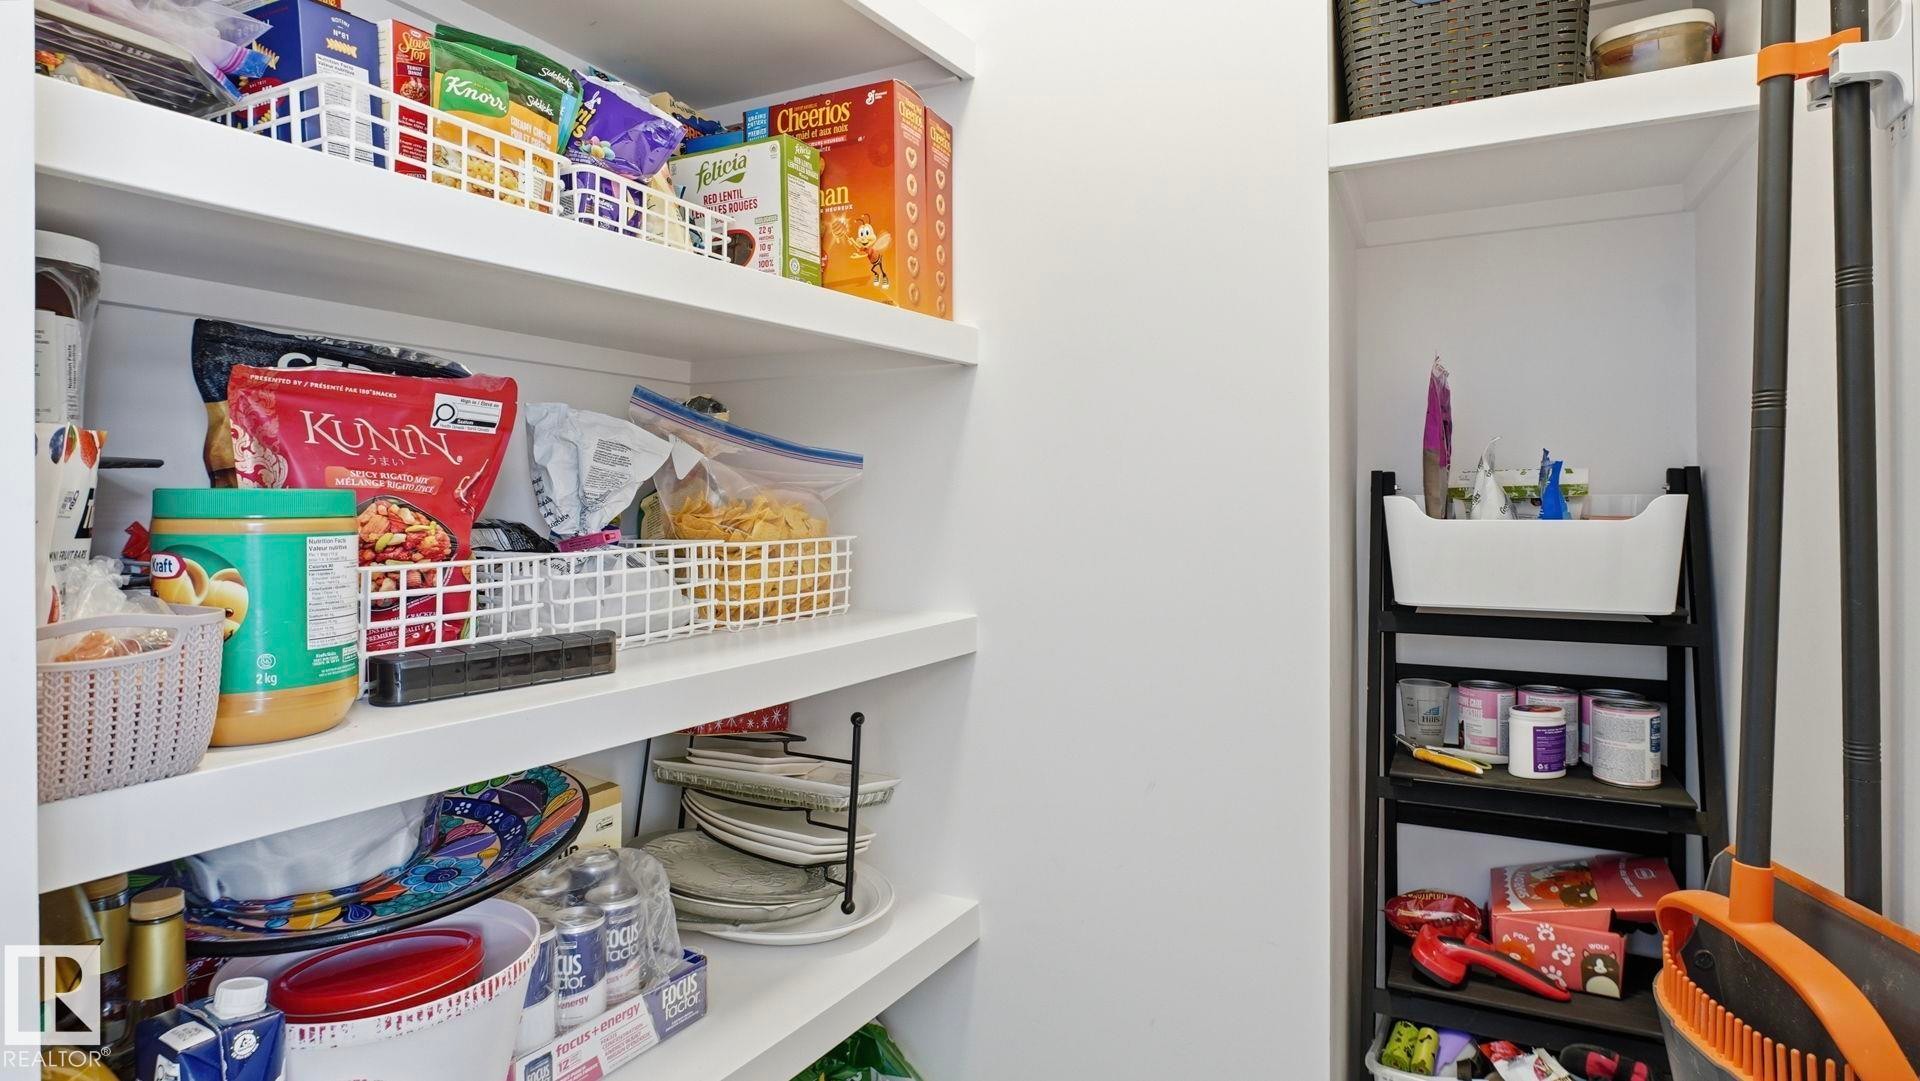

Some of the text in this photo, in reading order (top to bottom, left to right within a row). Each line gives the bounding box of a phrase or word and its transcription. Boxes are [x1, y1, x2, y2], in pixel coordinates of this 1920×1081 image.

[399, 32, 430, 53] Stove
[410, 49, 426, 63] Top
[445, 76, 507, 112] Knorr
[777, 100, 852, 134] Cheerios
[819, 126, 832, 137] aux
[833, 123, 849, 135] noix
[695, 153, 747, 194] felicia
[703, 189, 743, 206] RED LENTIL
[728, 199, 759, 214] ROUGES
[758, 226, 766, 235] 22
[759, 244, 766, 252] 10
[758, 259, 774, 268] 100%
[250, 374, 291, 385] PRESENTED
[309, 382, 344, 392] PRÉSENTÉ
[300, 410, 463, 465] KUNIN
[367, 454, 405, 467] うまい
[335, 477, 385, 488] MÉLANGE
[387, 481, 414, 491] RIGATO
[350, 469, 430, 484] SPICY RIGATO MIX
[152, 556, 173, 574] Kraft
[367, 630, 398, 642] REMIÈRE
[256, 672, 278, 686] 2 kg
[662, 973, 697, 1010] FOCUS
[665, 991, 701, 1021] factor
[558, 1059, 569, 1073] 12
